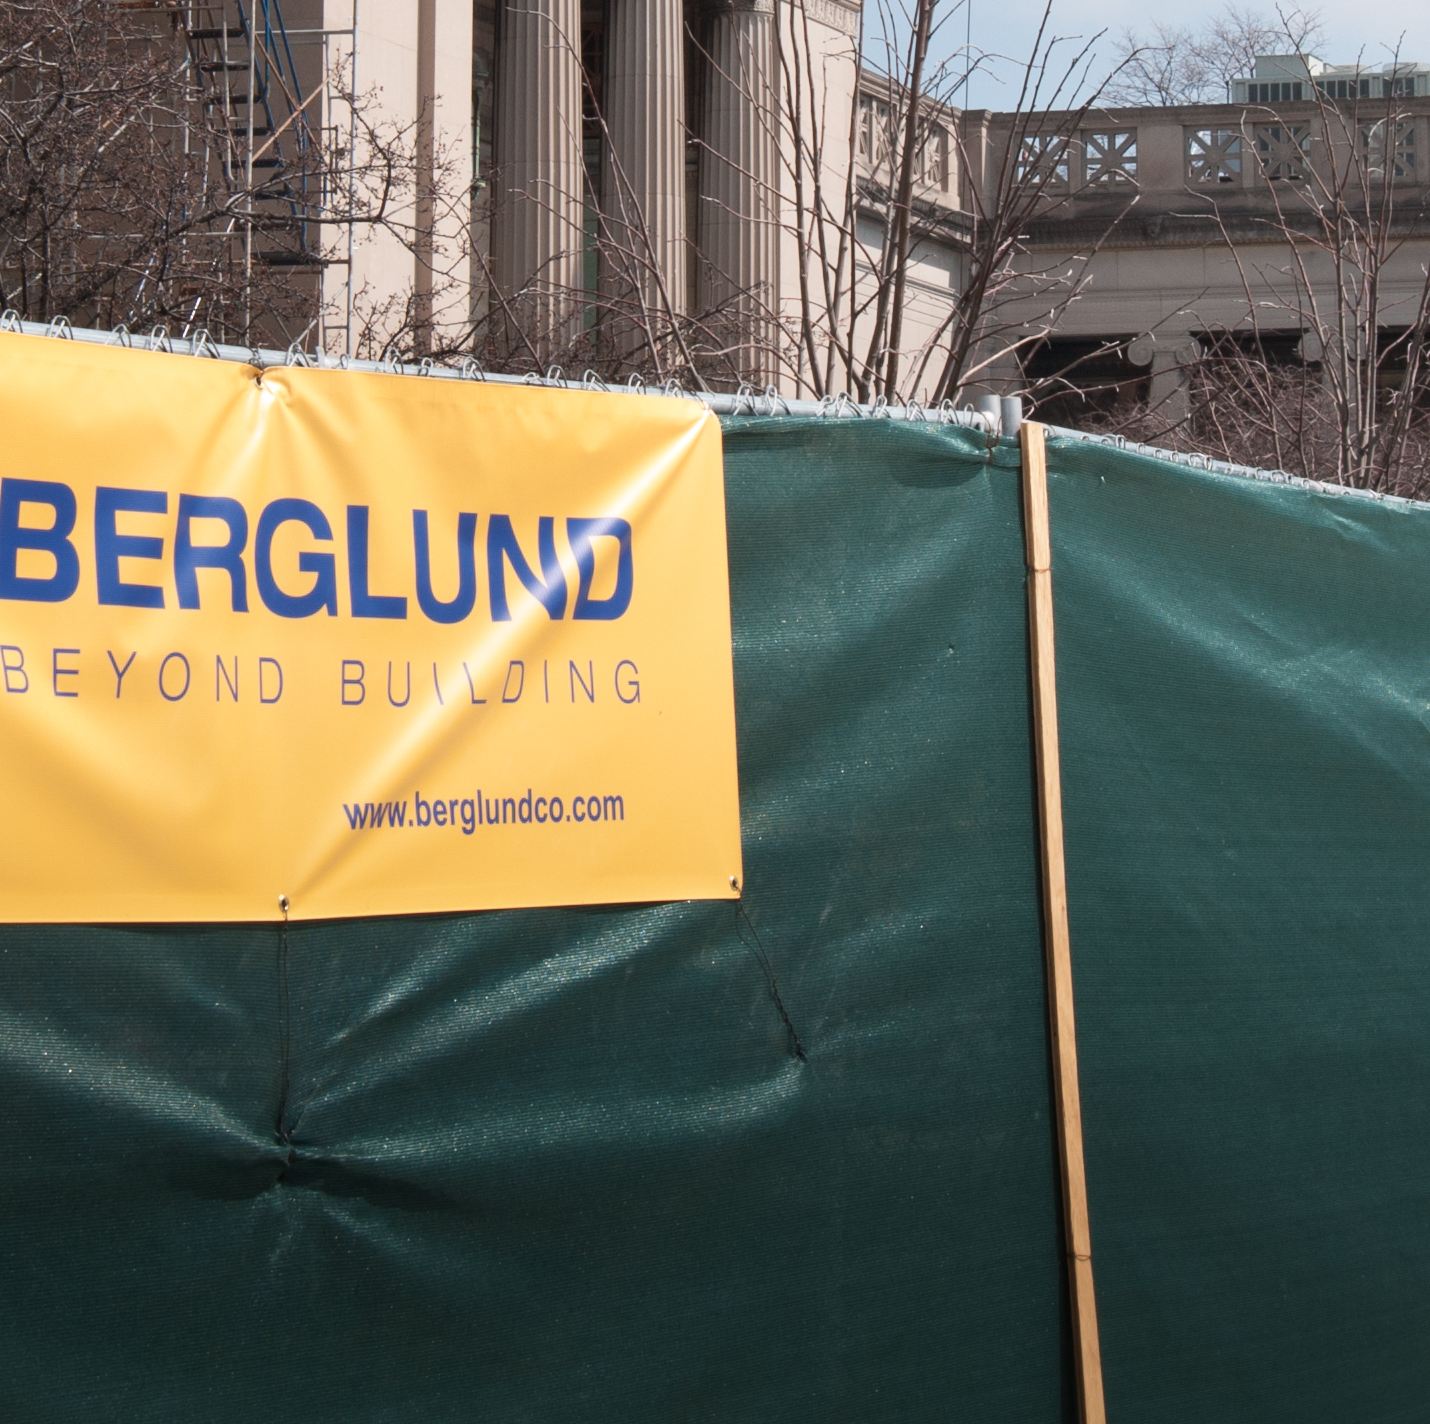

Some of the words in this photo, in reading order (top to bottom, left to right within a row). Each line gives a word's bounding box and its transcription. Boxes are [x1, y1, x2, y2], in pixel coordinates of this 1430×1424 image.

[0, 644, 284, 704] BEYOND
[341, 659, 641, 708] BUILDING
[342, 788, 625, 836] www.berglundco.com
